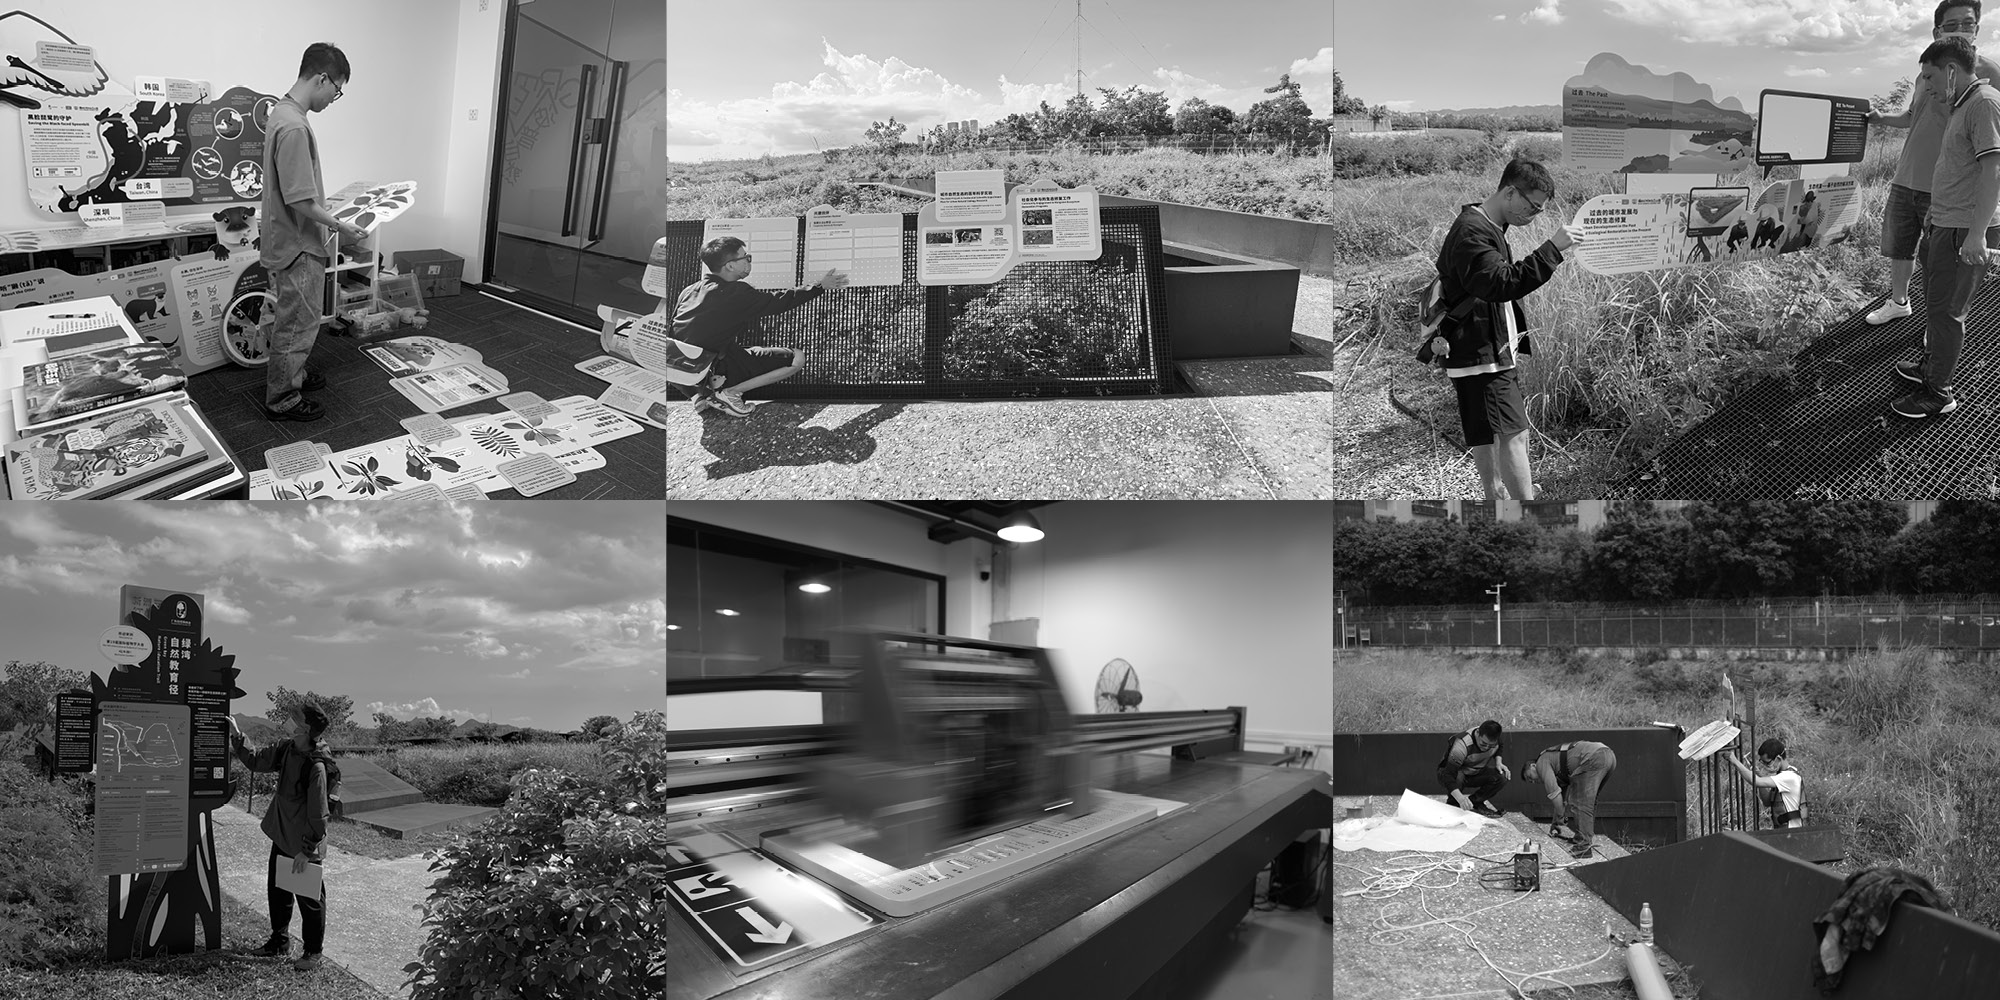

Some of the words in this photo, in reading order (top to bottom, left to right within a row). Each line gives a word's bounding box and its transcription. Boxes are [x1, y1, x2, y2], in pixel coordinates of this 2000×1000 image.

[169, 637, 179, 695] 自然教育径
